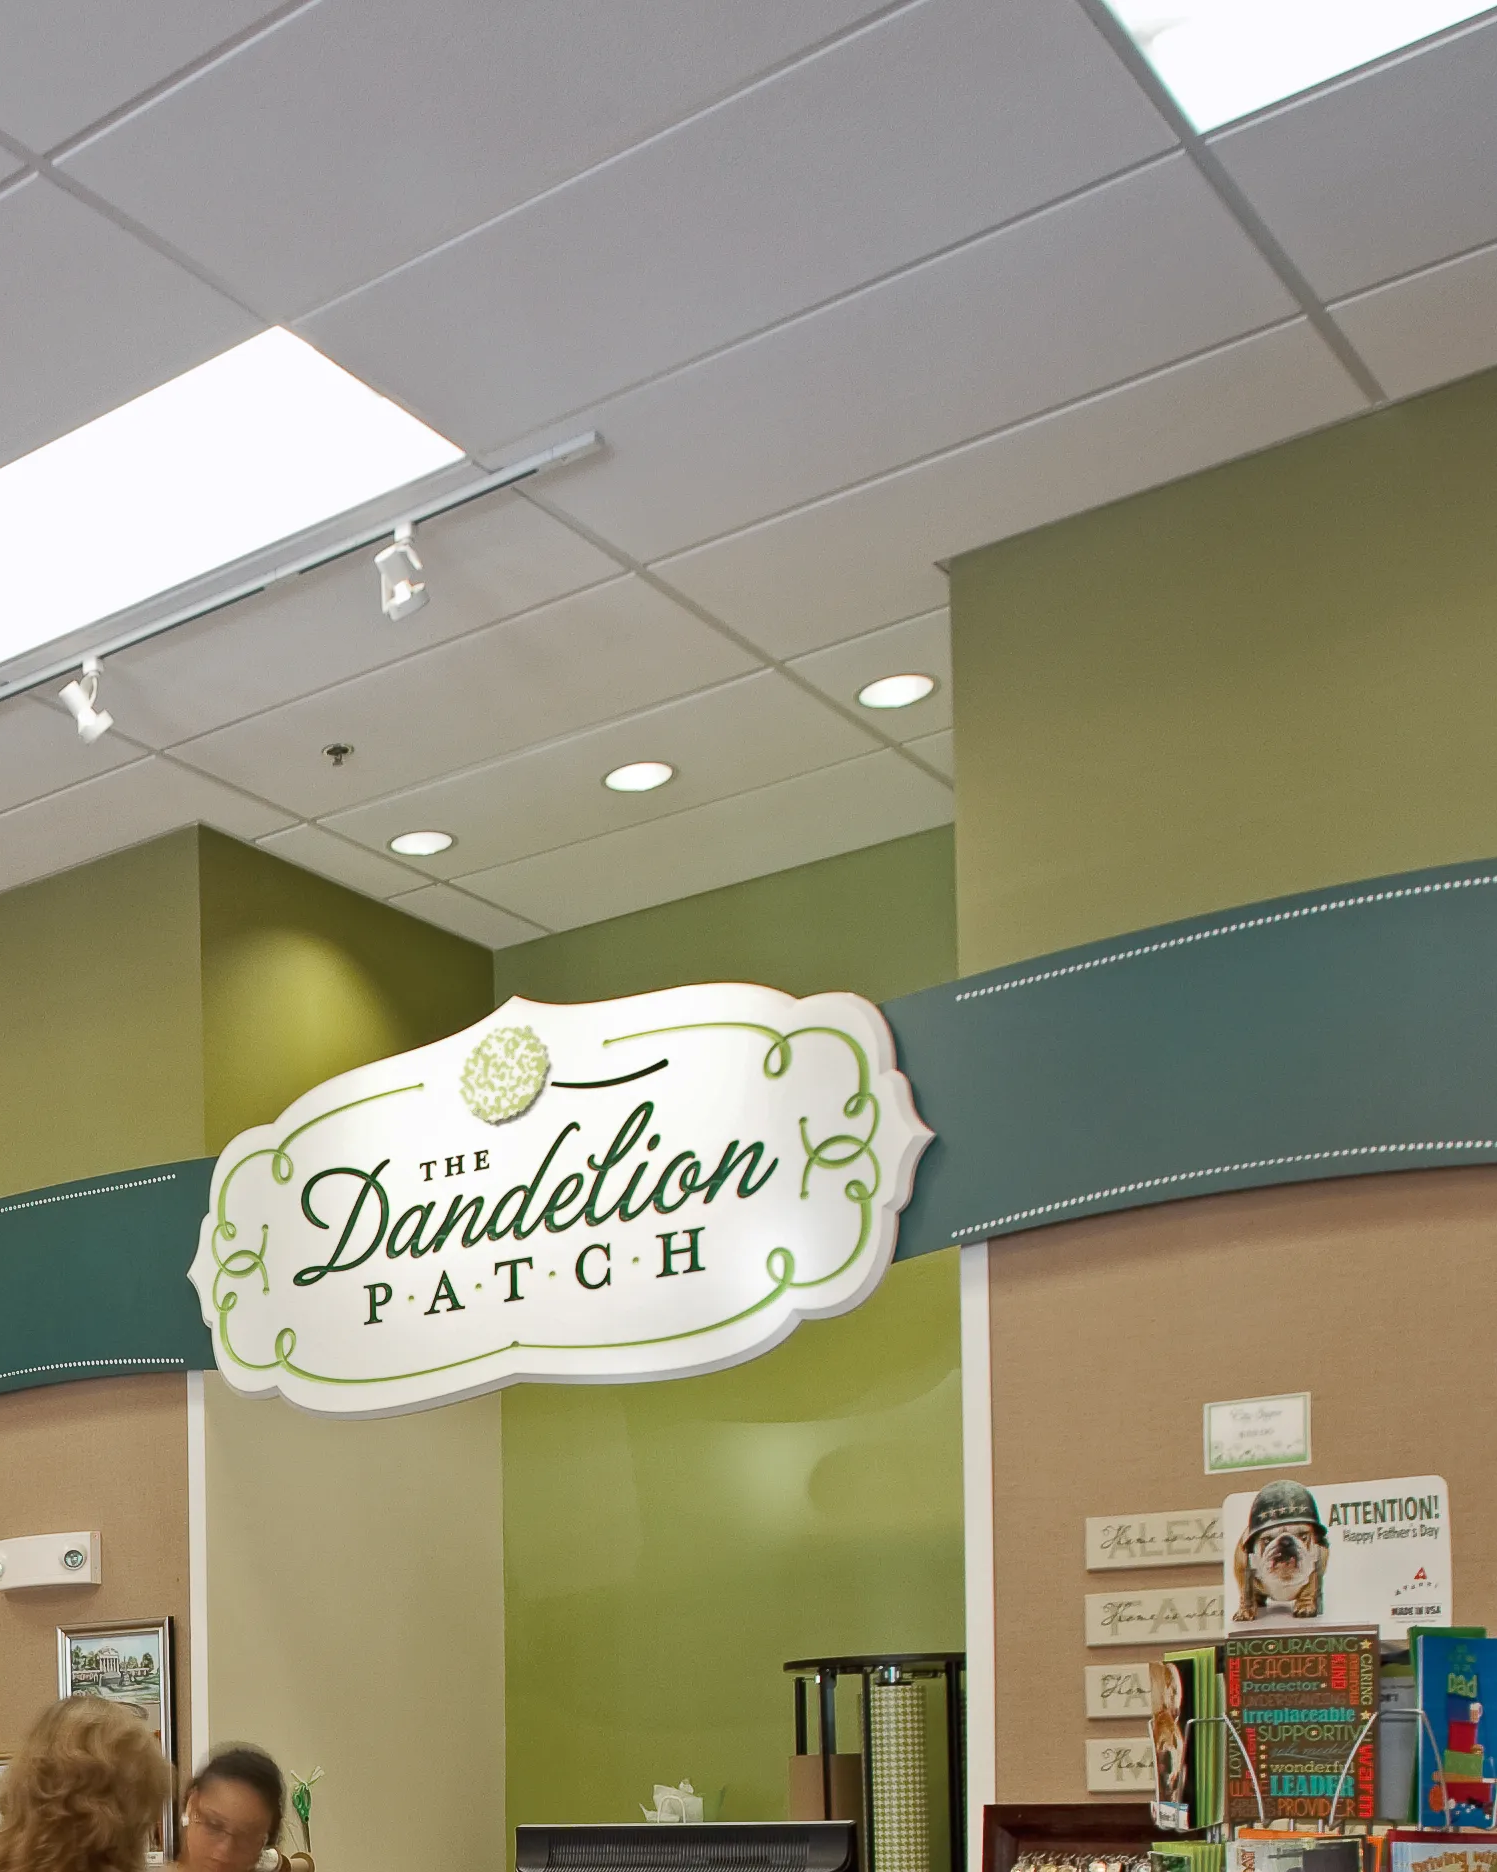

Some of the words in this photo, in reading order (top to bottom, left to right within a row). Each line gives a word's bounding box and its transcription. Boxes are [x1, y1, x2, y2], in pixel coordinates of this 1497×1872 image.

[419, 1148, 491, 1182] THE
[293, 1100, 779, 1287] Dandelion
[1328, 1495, 1440, 1528] ATTENTION!
[1342, 1528, 1375, 1545] Happy
[1377, 1523, 1418, 1540] Father's
[1420, 1524, 1440, 1540] Day
[1415, 1607, 1423, 1615] IN
[1226, 1637, 1359, 1656] ENCOURAGING
[1242, 1654, 1328, 1679] TEACHER
[1242, 1680, 1320, 1692] Protector
[1361, 1654, 1373, 1705] CARING
[1448, 1672, 1478, 1698] Dad
[1270, 1775, 1355, 1796] LEADER
